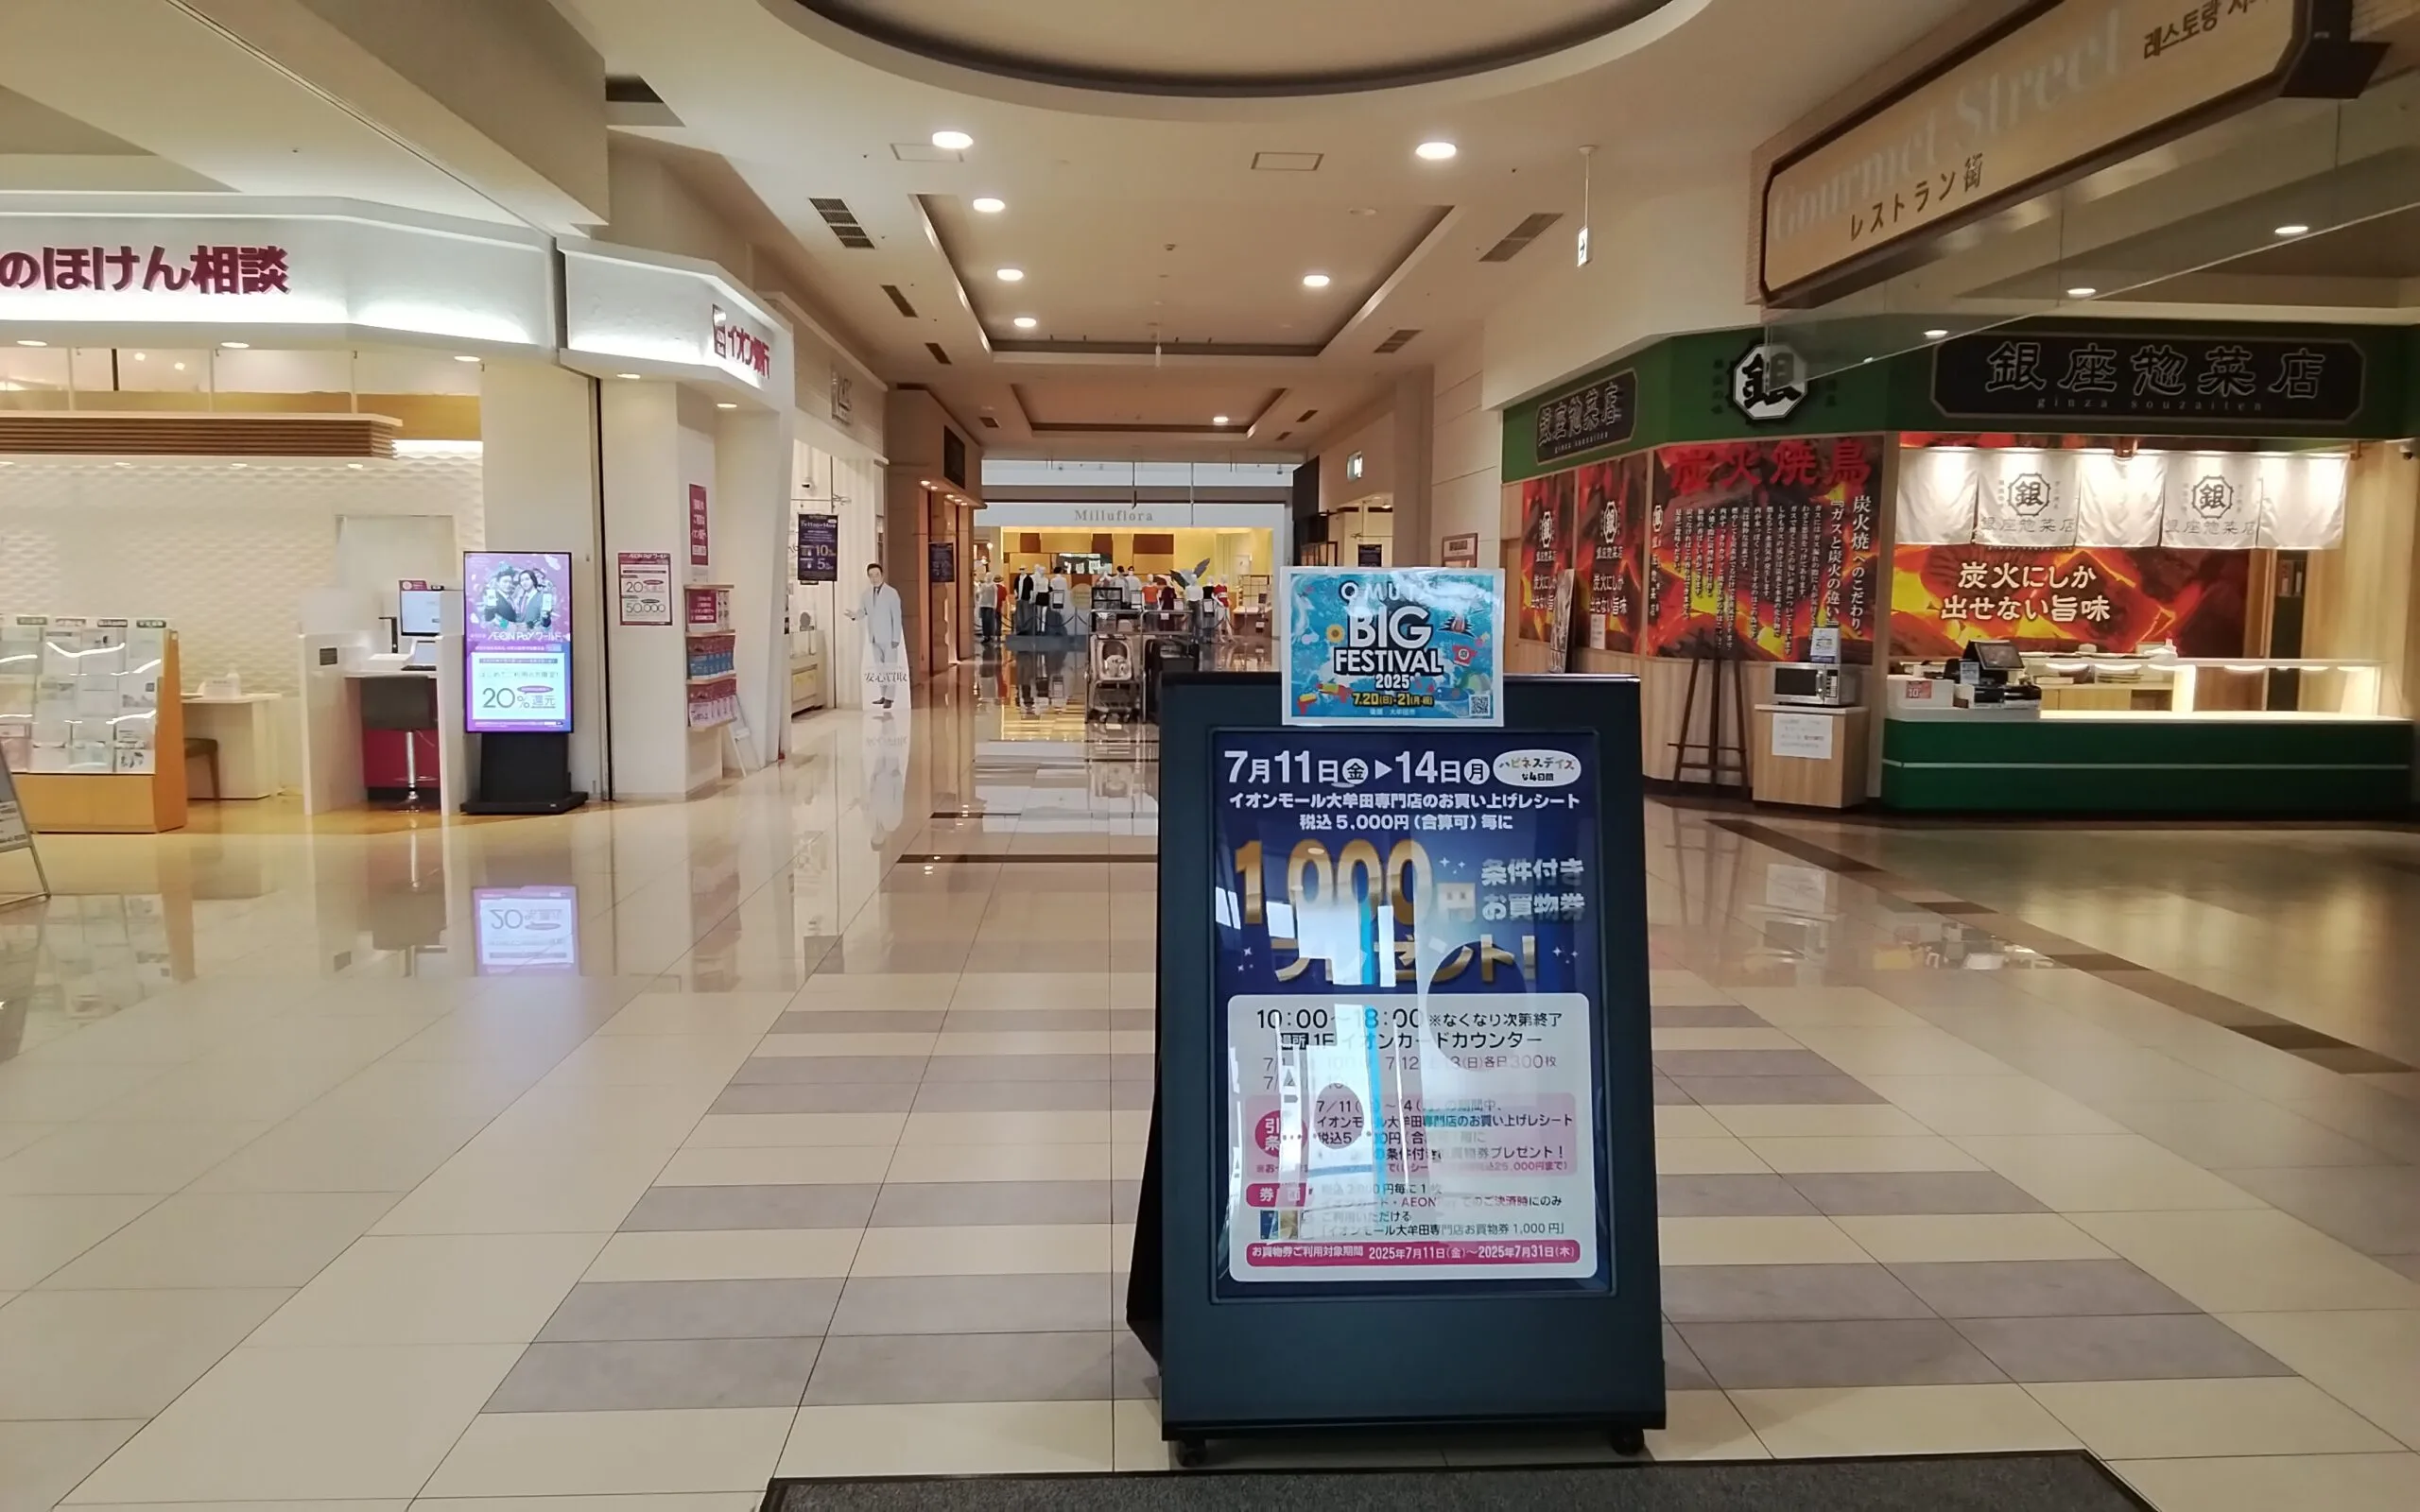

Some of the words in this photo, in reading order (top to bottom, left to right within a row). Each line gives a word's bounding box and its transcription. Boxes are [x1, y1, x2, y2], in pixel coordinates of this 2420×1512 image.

[1849, 151, 1984, 243] レストラン街
[0, 245, 291, 295] のほけん相談
[1985, 340, 2327, 399] 銀座惣菜店
[2037, 398, 2110, 410] ginza
[1671, 441, 1873, 489] 炭火焼鳥
[1074, 508, 1154, 522] Milluflora
[1959, 562, 2098, 589] 炭火にしか
[1940, 594, 2111, 623] 出せない旨味
[1349, 605, 1432, 648] BIG
[1335, 649, 1443, 673] FESTIVAL
[1375, 674, 1409, 688] 2025
[1229, 792, 1581, 810] イオンモール大牟田専門店のお買い上げレシート
[1480, 857, 1585, 886] 条件付き
[1480, 893, 1585, 921] お買物券
[1252, 1245, 1364, 1259] お買物券ご利用対象期間
